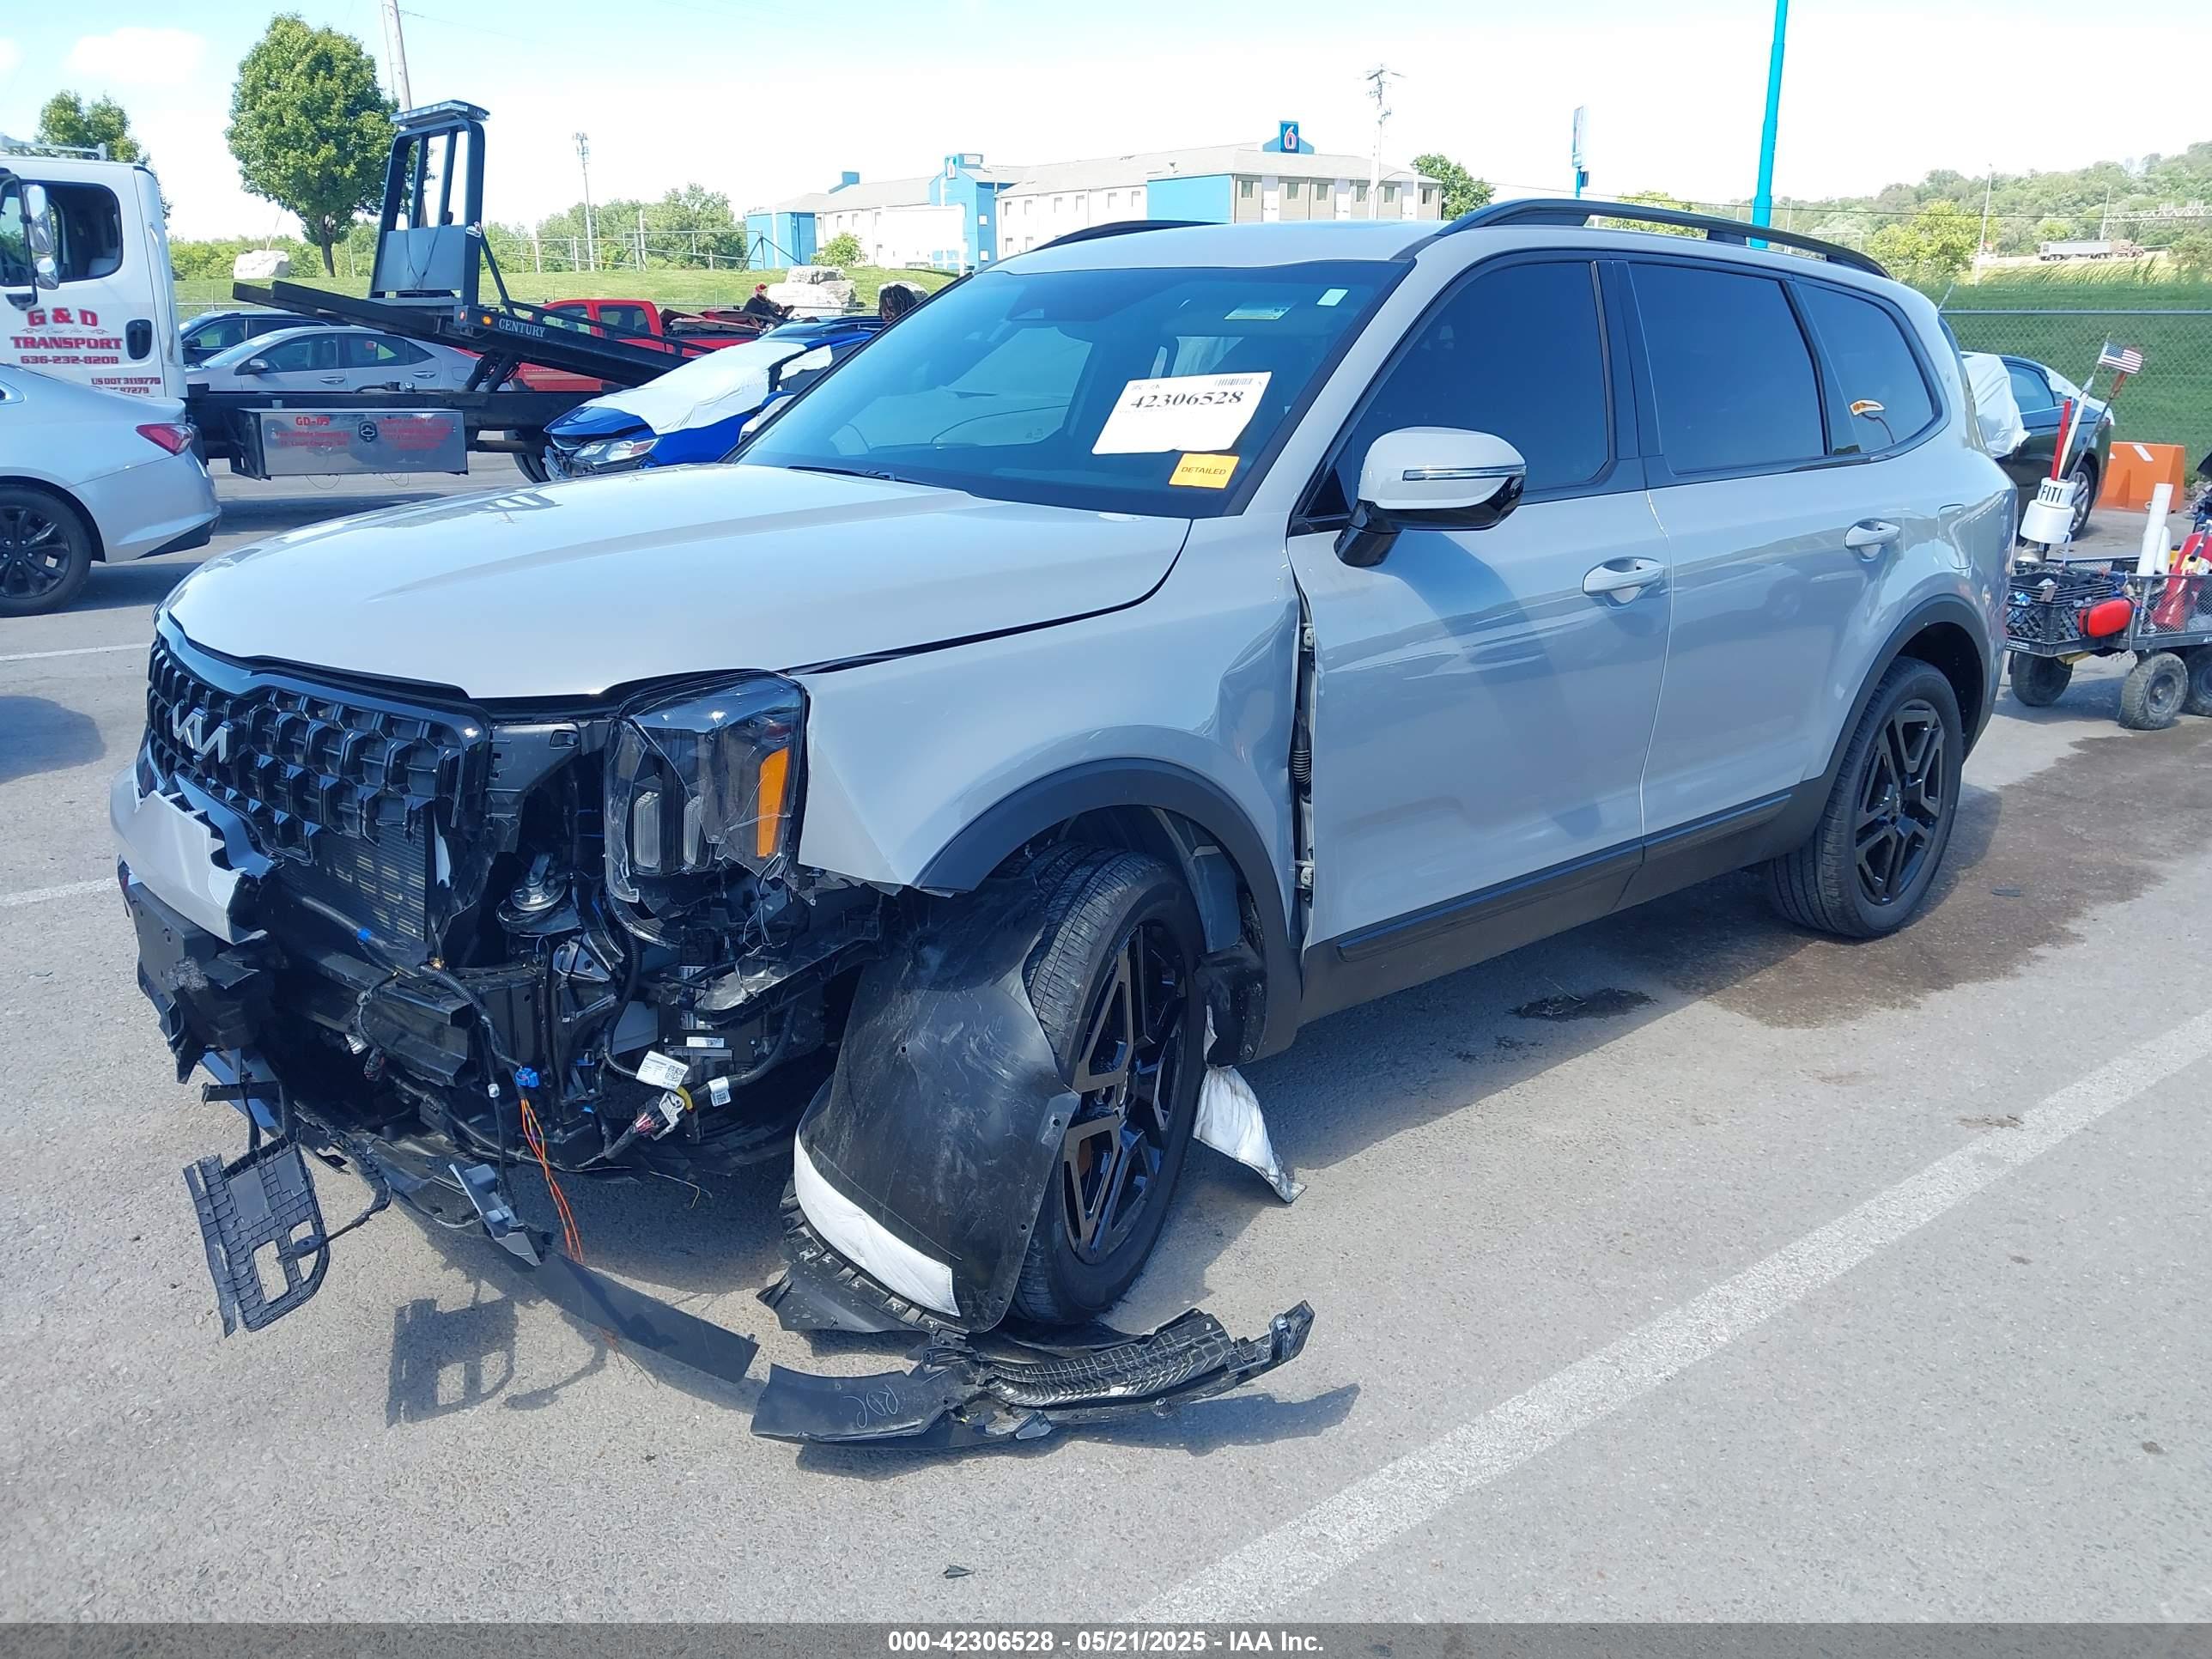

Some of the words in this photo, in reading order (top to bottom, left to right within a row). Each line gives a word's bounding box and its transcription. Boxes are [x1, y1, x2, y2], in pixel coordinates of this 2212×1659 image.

[1284, 125, 1297, 150] 6
[27, 309, 46, 326] G
[52, 307, 73, 324] &
[78, 309, 98, 326] D
[499, 318, 546, 337] CENTURY
[10, 337, 123, 349] TRANSPORT
[1130, 391, 1244, 409] 42306528
[1181, 466, 1227, 476] DETAILED
[172, 701, 230, 763] KIA
